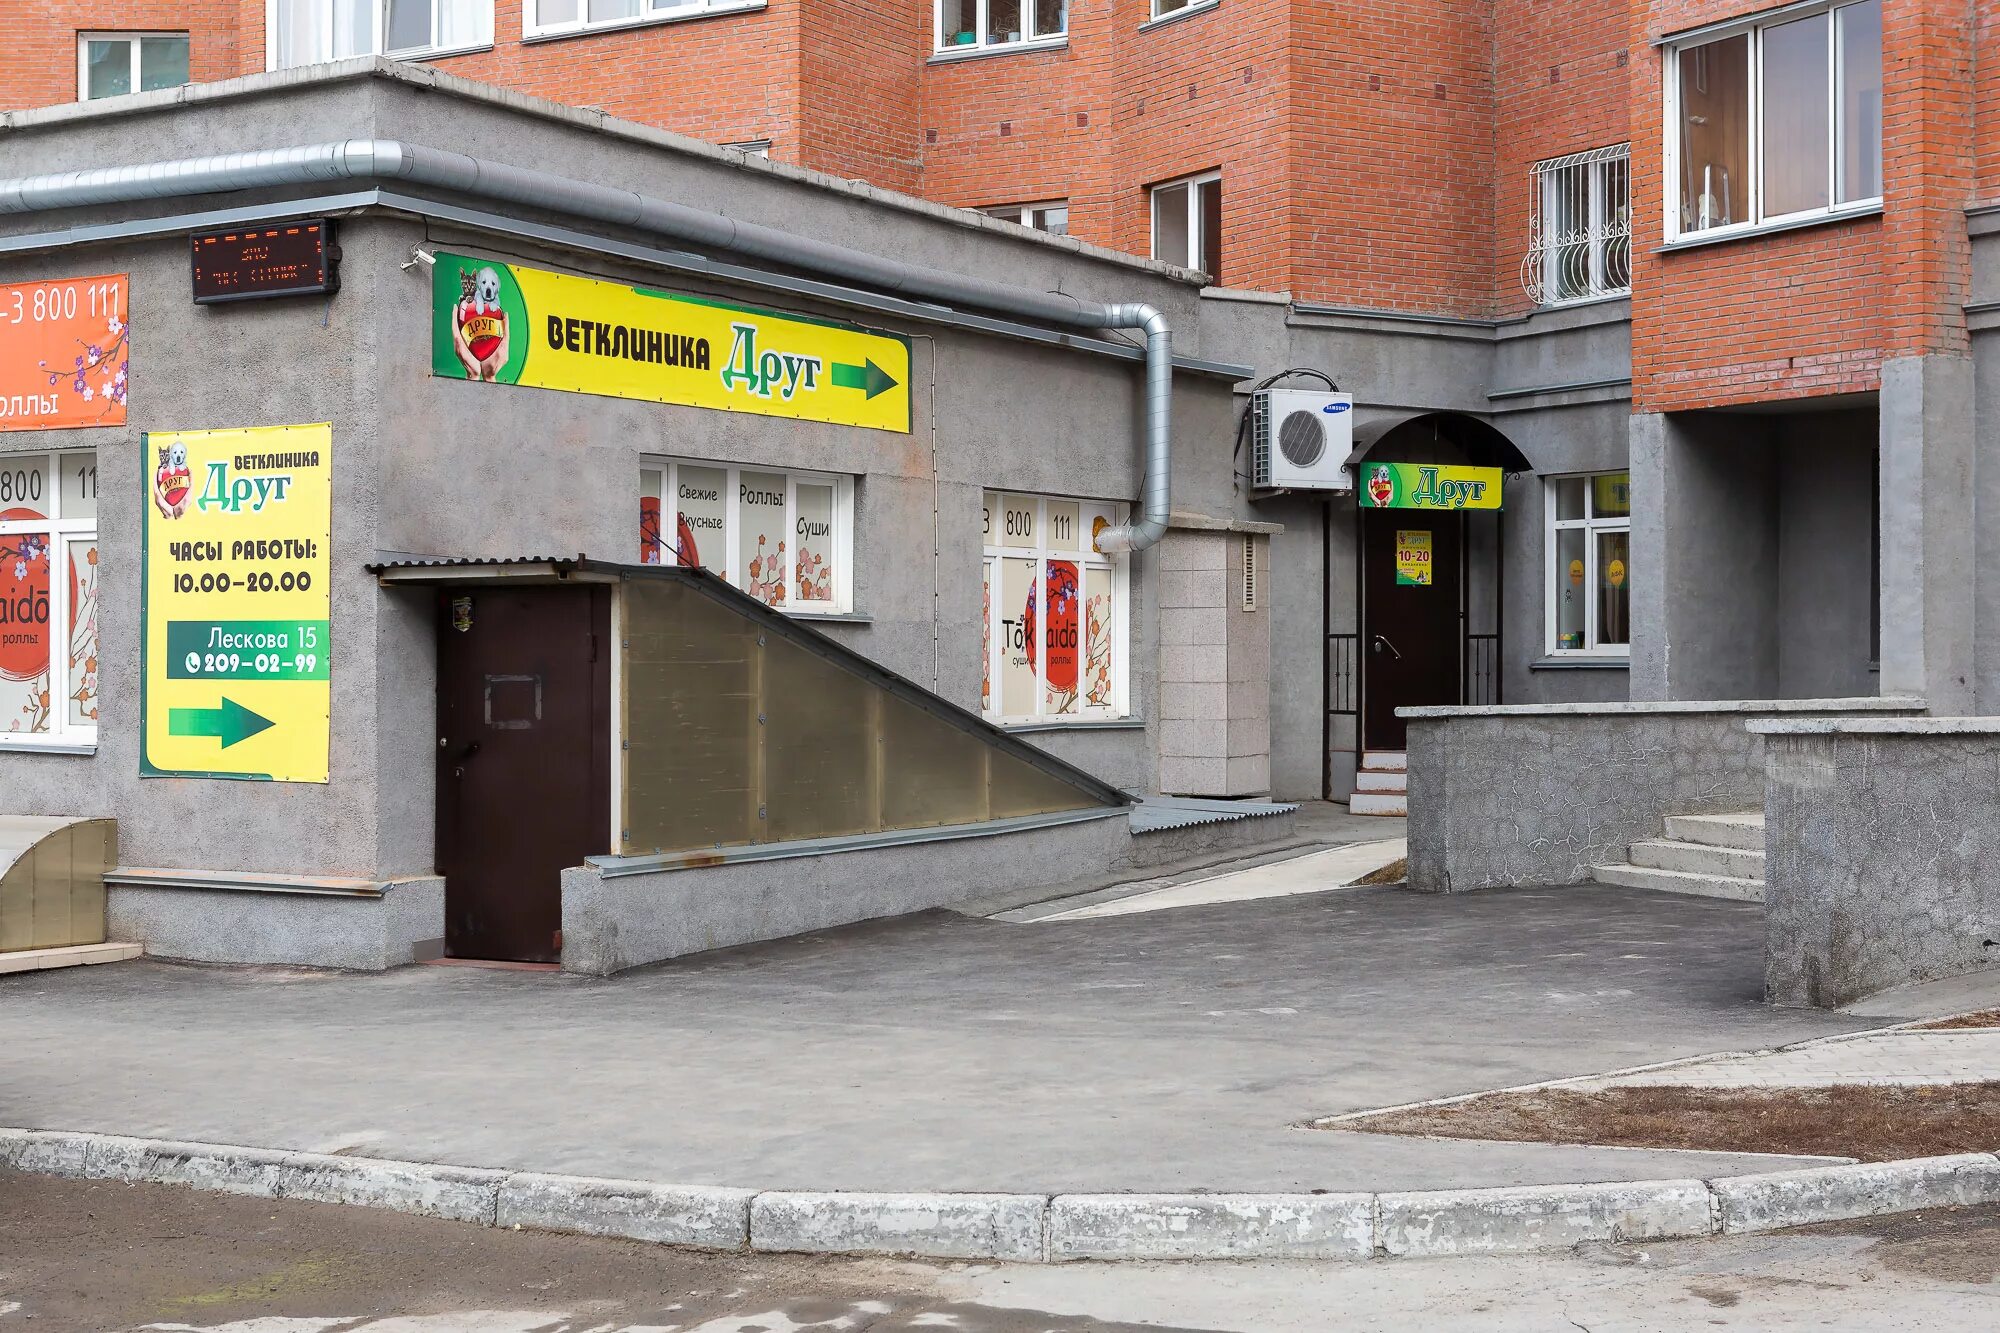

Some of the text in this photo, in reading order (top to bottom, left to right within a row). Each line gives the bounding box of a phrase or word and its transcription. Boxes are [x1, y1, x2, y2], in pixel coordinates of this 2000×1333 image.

[33, 286, 77, 322] 800
[88, 282, 119, 317] 111
[468, 319, 495, 337] ДРУГ
[547, 314, 711, 371] ВЕТКЛИНИКА
[722, 324, 820, 399] Друг
[234, 451, 319, 470] ВЕТКЛИНИКА
[1, 469, 42, 502] 800
[164, 476, 183, 492] ДРУГ
[197, 463, 291, 512] Друг
[679, 483, 718, 501] Свежие
[1412, 467, 1486, 507] Друг
[740, 484, 784, 507] Роллы
[679, 511, 723, 532] Вкусные
[796, 516, 829, 541] Суши
[1006, 510, 1031, 537] 800
[1053, 514, 1070, 540] 111
[170, 539, 317, 561] ЧАСЫ РАБОТЫ:
[1399, 550, 1429, 562] 10-20
[174, 571, 311, 593] 10.00-20.00
[2, 633, 39, 648] роллы
[207, 626, 317, 649] Лескова 15
[204, 653, 317, 673] 209-02-99
